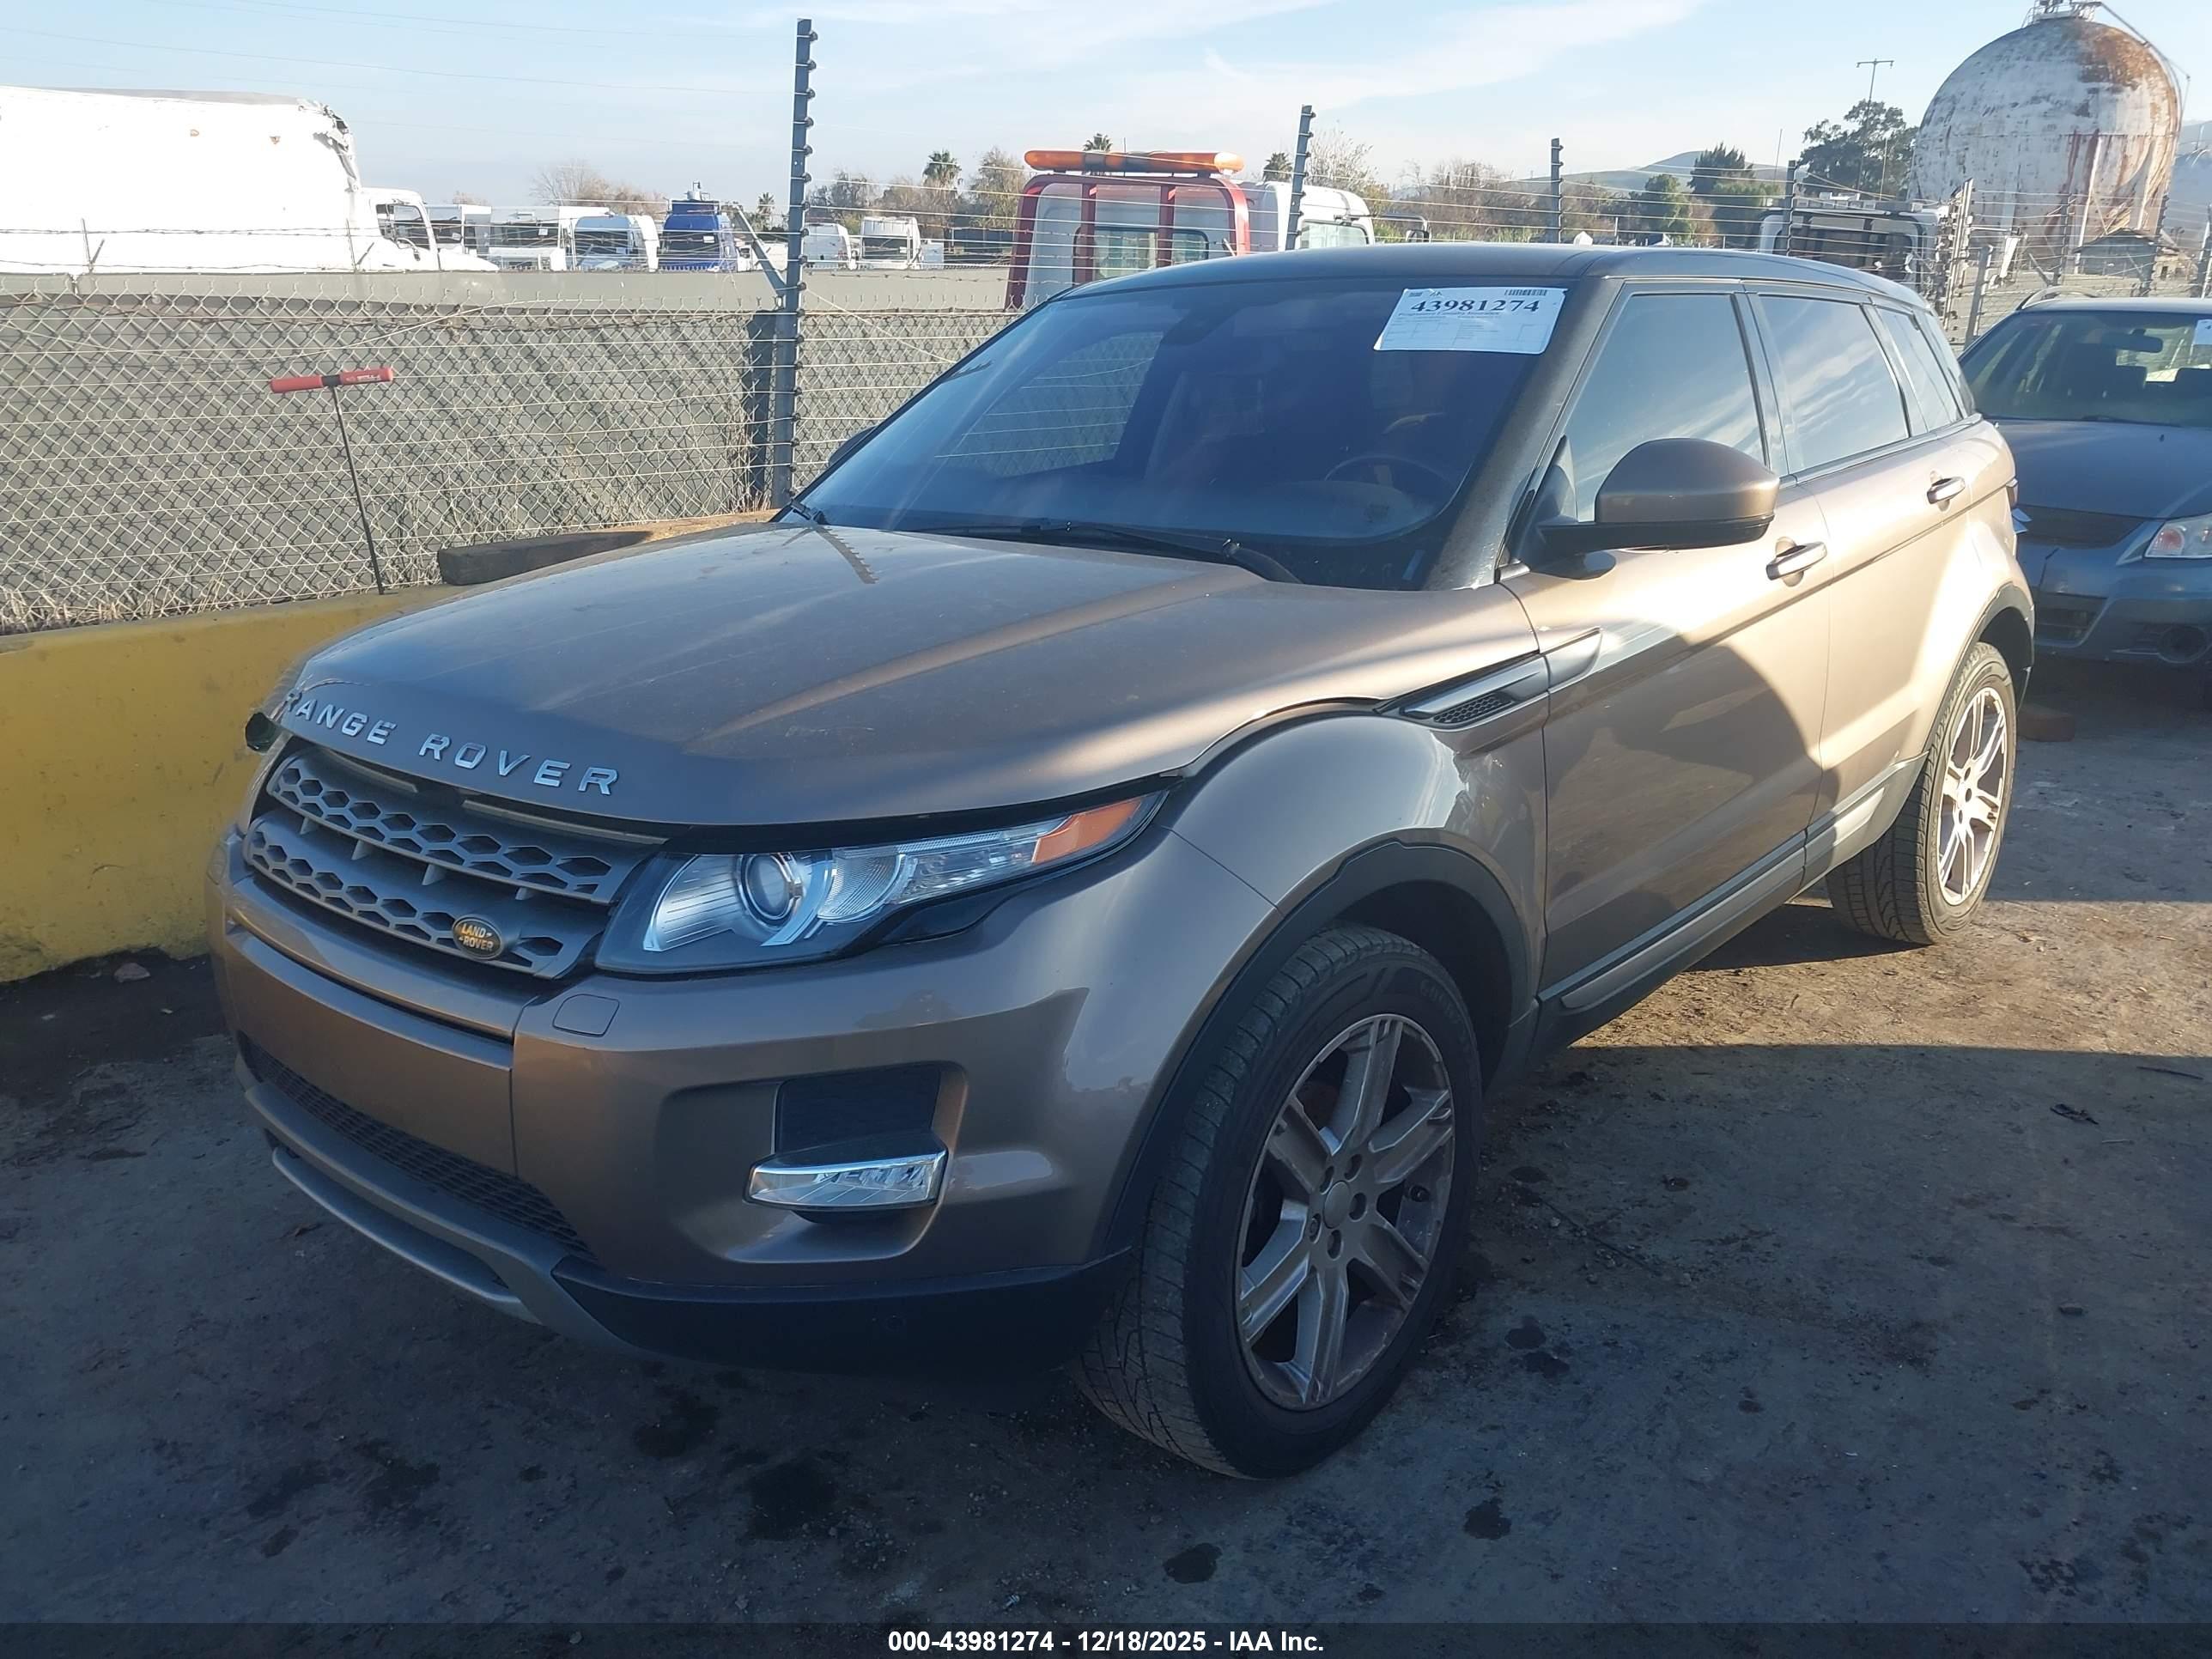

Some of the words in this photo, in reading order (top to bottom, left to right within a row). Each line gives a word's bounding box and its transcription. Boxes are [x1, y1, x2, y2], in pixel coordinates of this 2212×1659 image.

[1411, 300, 1539, 313] 43981274
[287, 690, 398, 745] RANGE
[418, 732, 619, 796] ROVER
